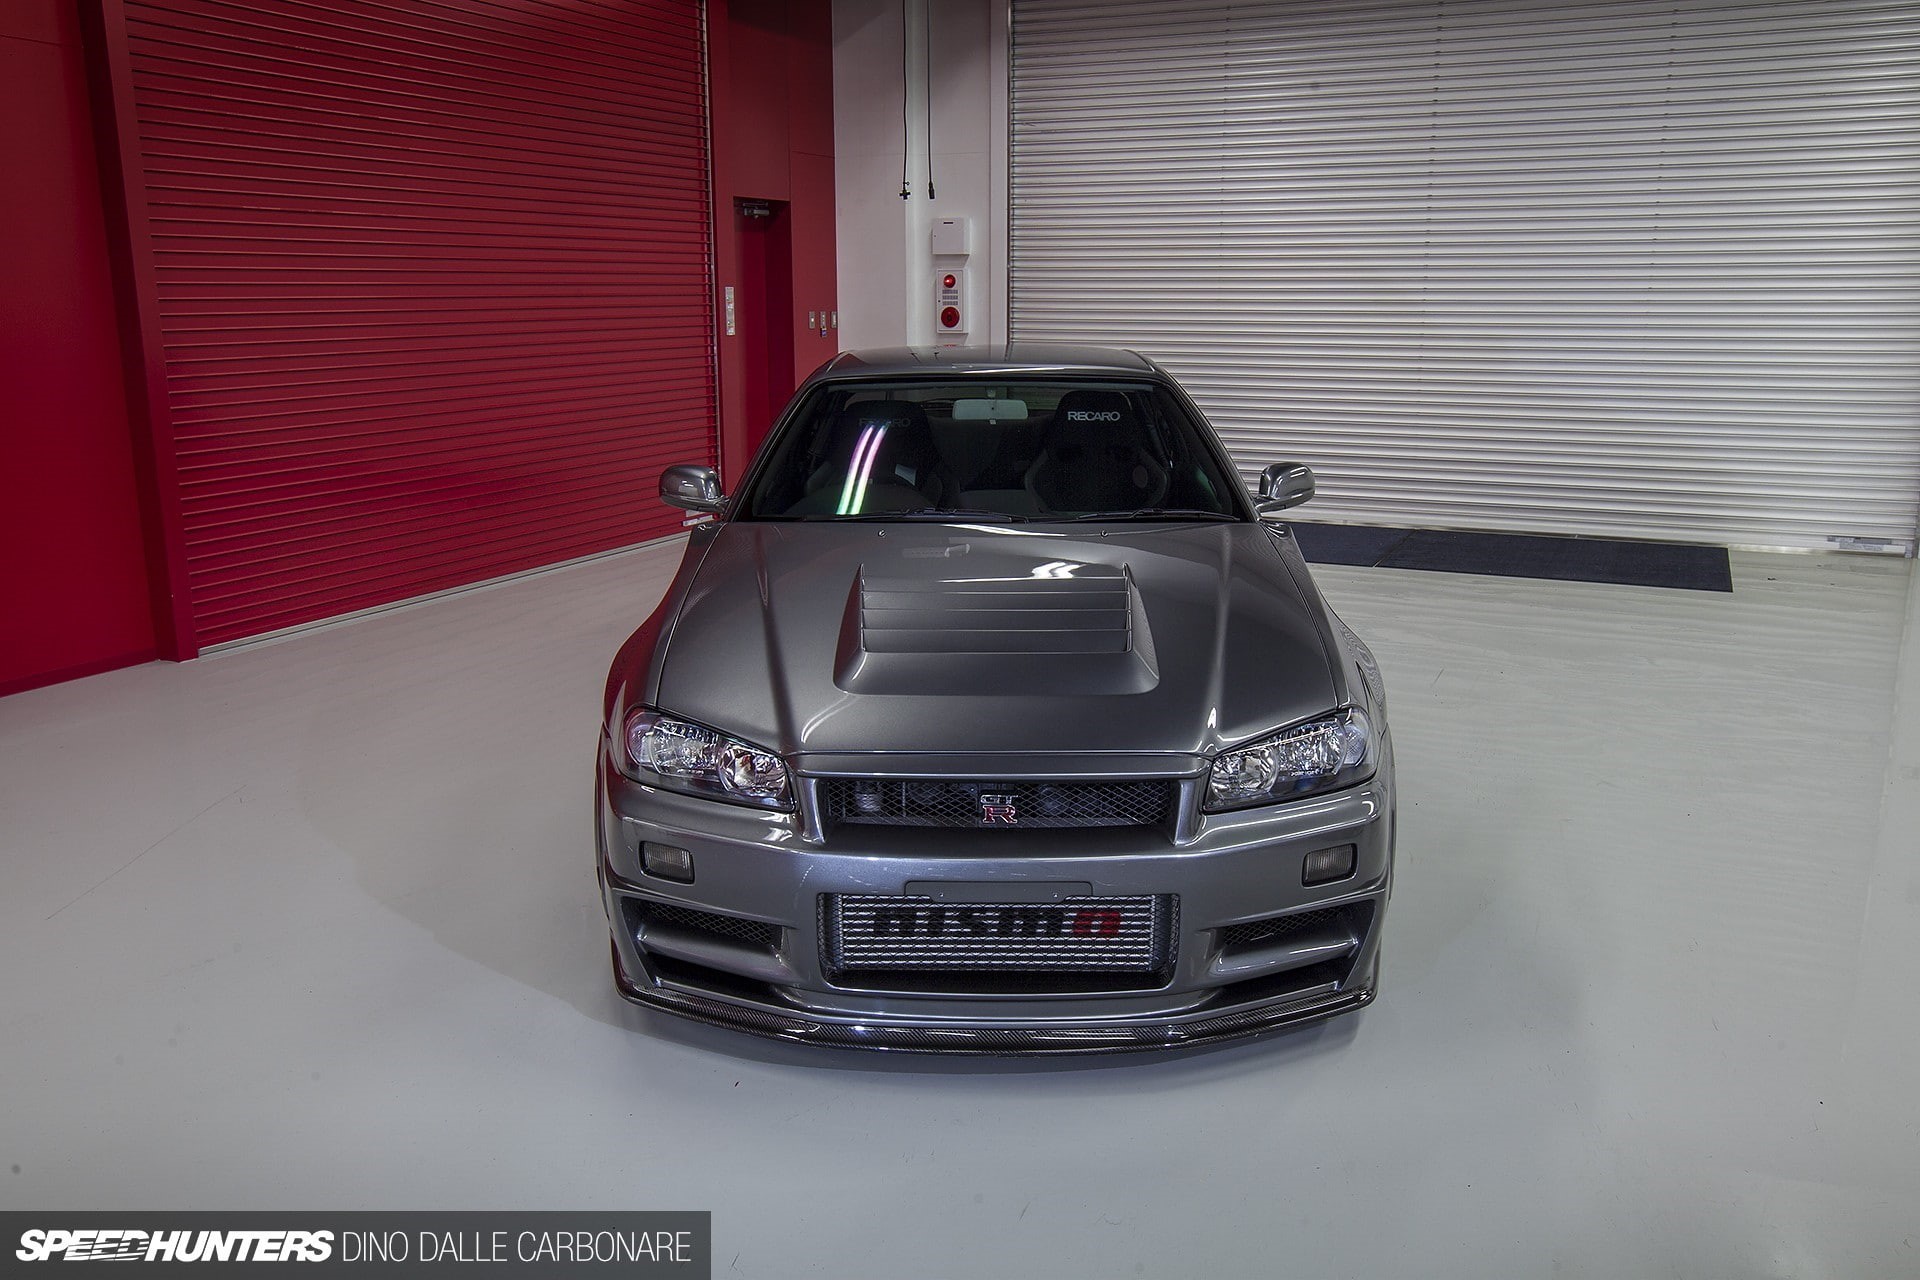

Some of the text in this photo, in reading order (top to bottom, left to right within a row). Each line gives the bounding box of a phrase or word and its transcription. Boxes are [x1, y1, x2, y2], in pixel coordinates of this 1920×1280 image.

[1067, 411, 1120, 422] RECARO
[859, 417, 912, 428] RARO
[980, 794, 1019, 804] GT
[982, 804, 1018, 824] R
